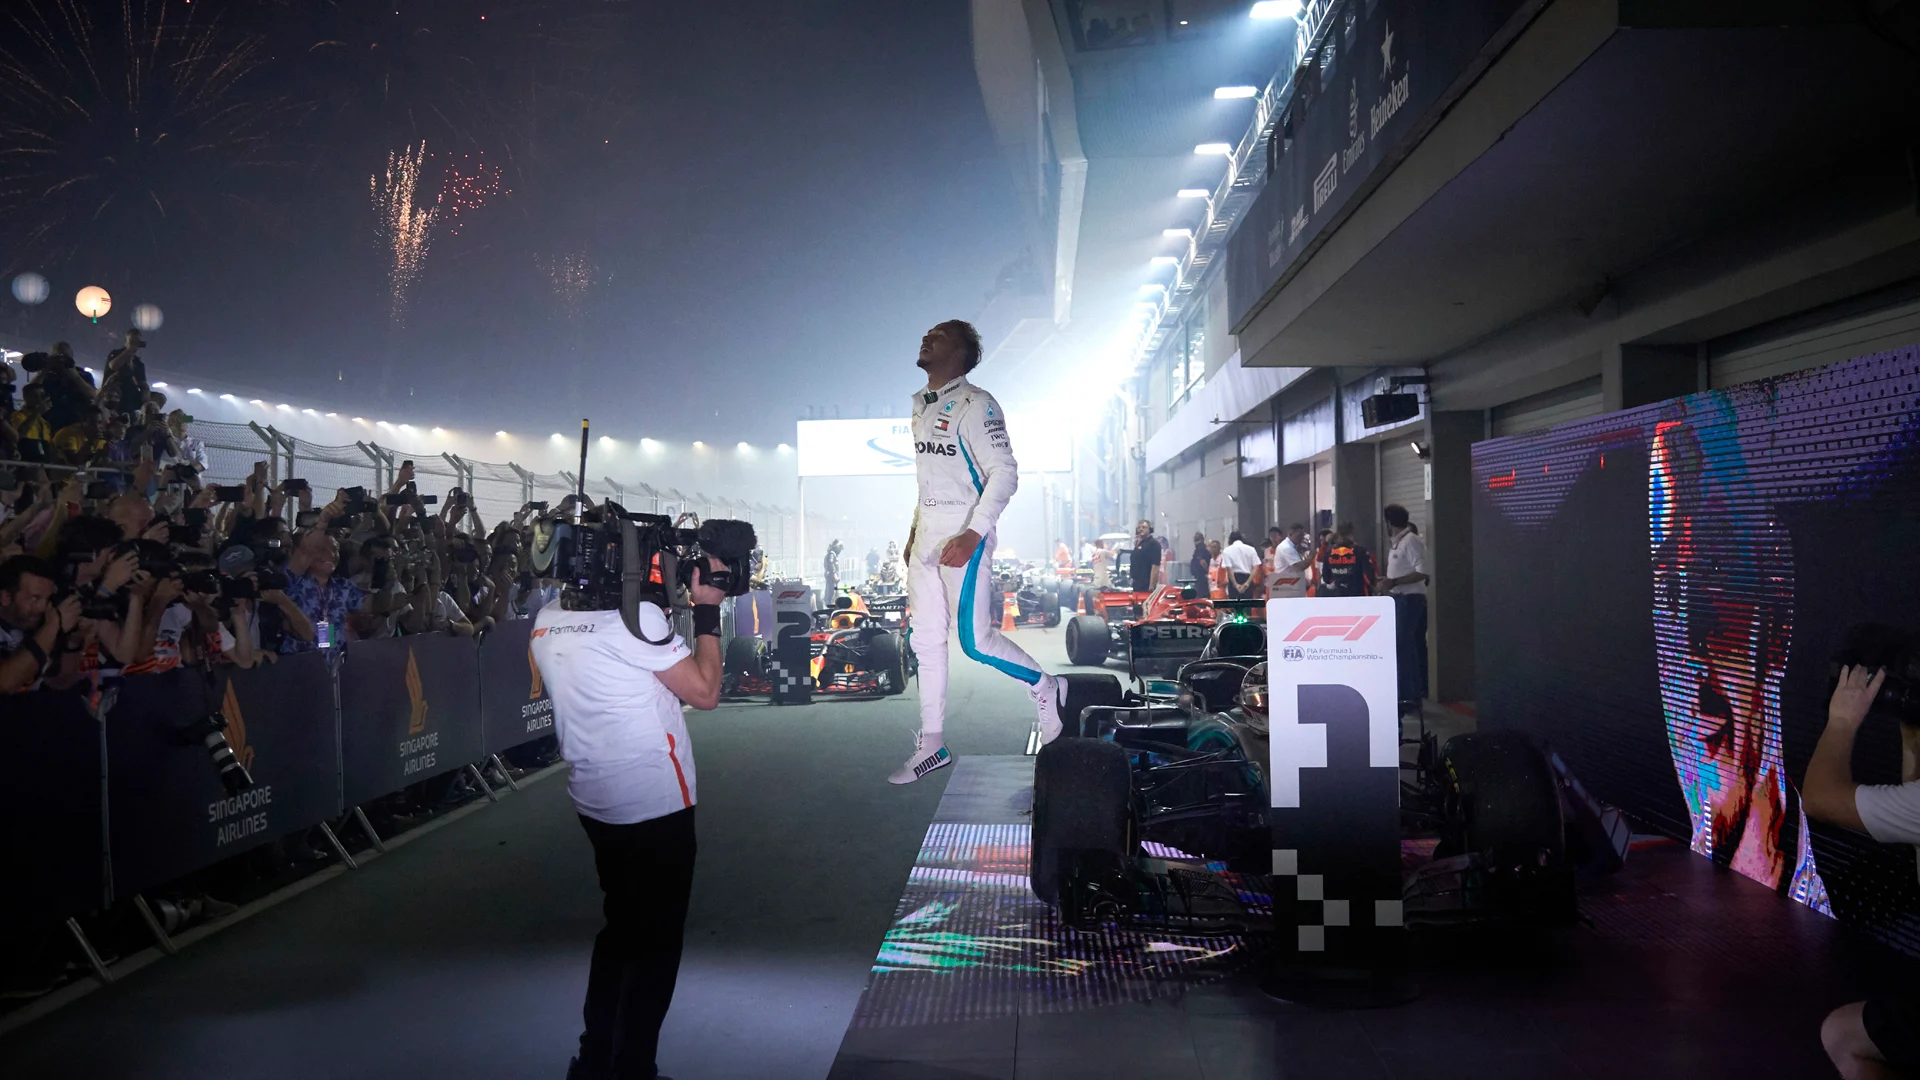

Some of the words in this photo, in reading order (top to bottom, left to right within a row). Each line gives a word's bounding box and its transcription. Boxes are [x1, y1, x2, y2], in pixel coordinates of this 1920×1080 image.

[1370, 73, 1409, 140] Heineken
[1343, 131, 1365, 174] Emirates
[1313, 152, 1338, 215] PIRELLI
[983, 420, 1004, 428] EPSON
[991, 433, 1006, 442] IWC
[1331, 567, 1348, 575] Mobil
[549, 624, 589, 635] Formula
[588, 623, 596, 633] 1
[777, 611, 811, 648] 2
[1307, 653, 1327, 661] World
[1328, 653, 1378, 661] Championship
[526, 713, 552, 733] AIRLINES
[399, 732, 438, 757] SINGAPORE
[404, 752, 436, 776] AIRLINES
[913, 752, 942, 778] PUMA
[208, 785, 272, 823] SINGAPORE
[216, 811, 268, 847] AIRLINES
